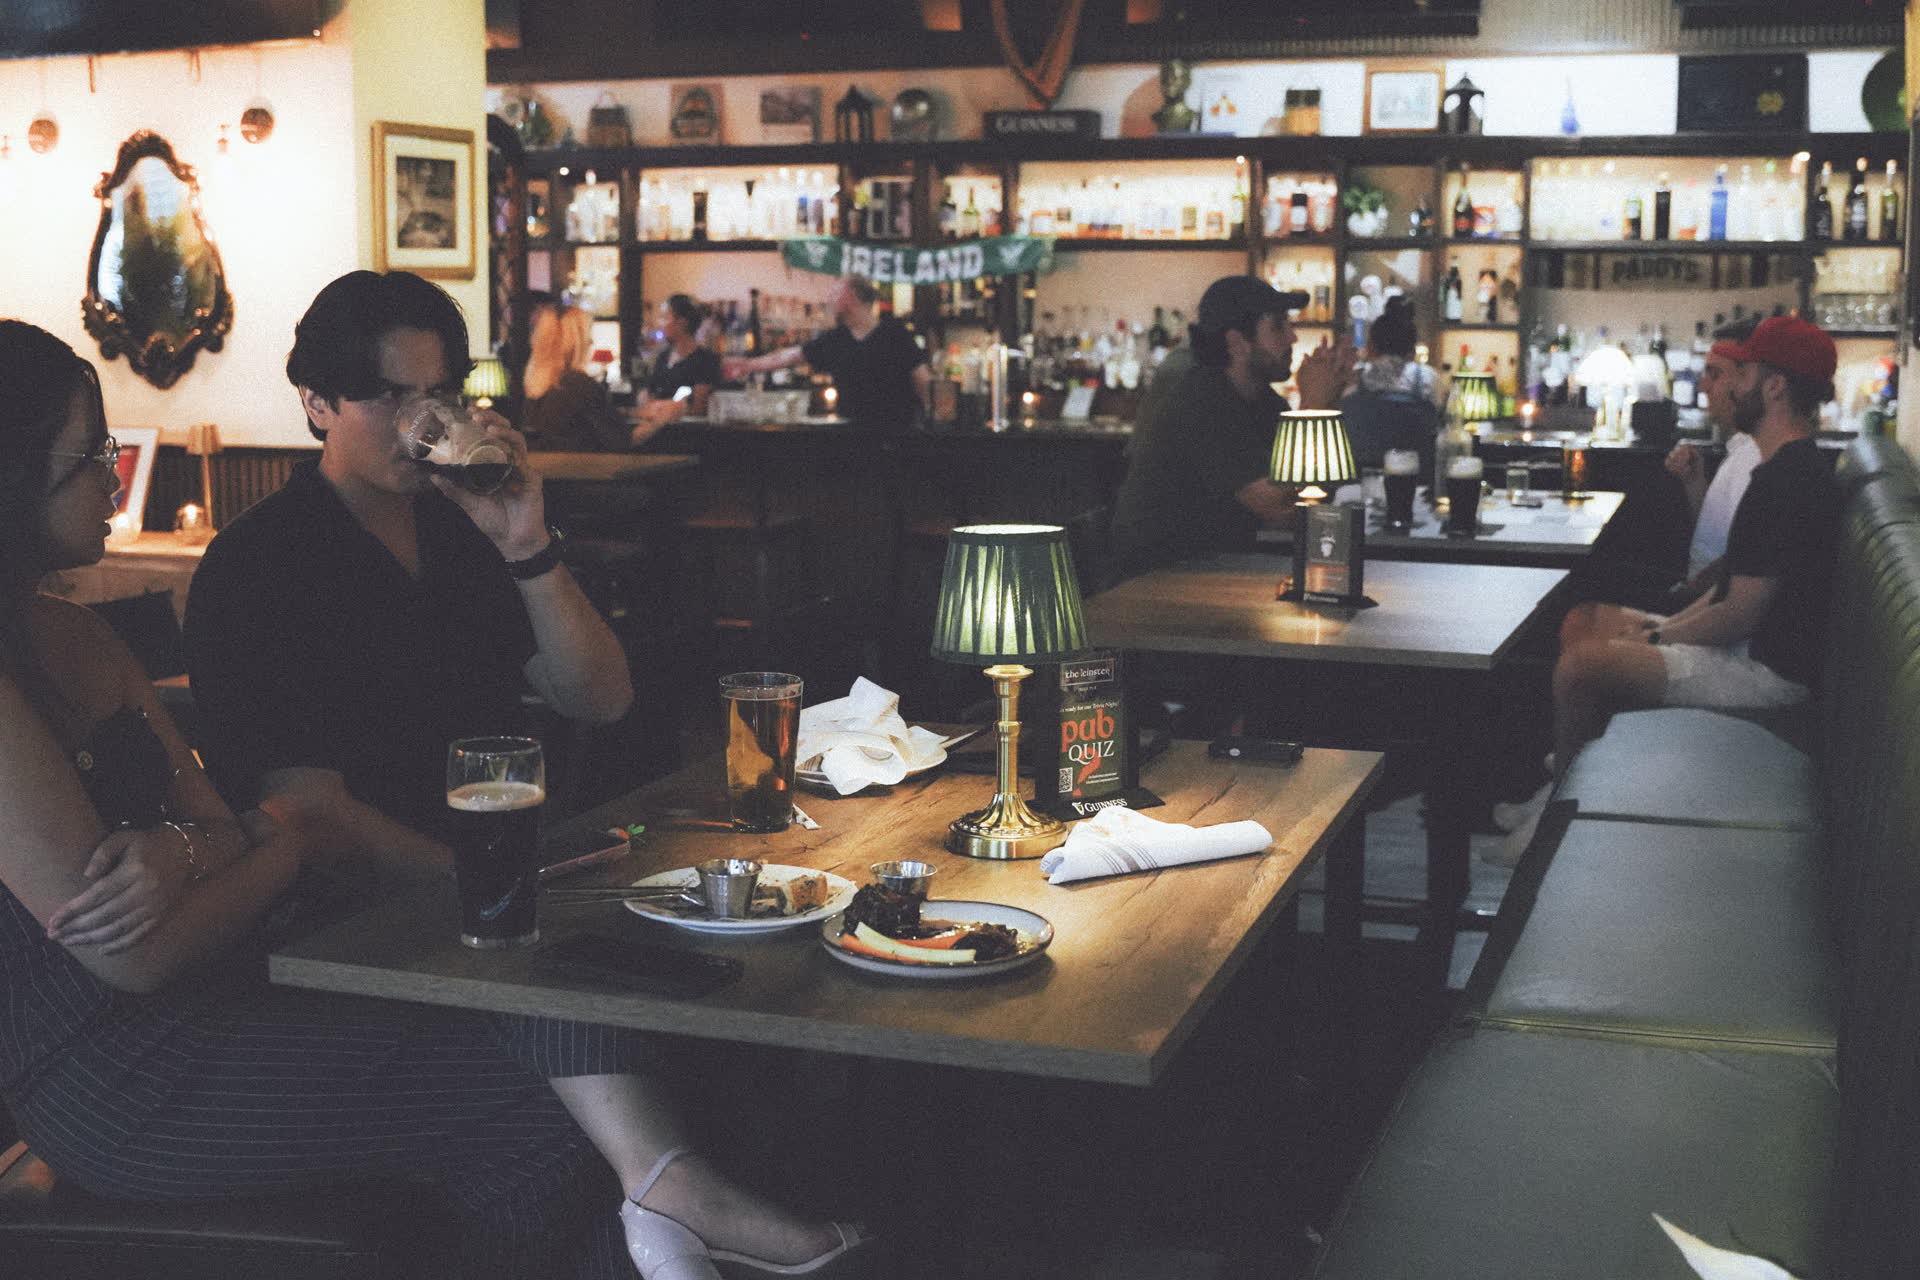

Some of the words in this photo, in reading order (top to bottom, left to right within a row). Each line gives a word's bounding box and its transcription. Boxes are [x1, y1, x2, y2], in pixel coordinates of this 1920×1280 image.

[841, 245, 984, 284] IRELAND
[1065, 669, 1079, 679] the
[1061, 708, 1115, 753] pub
[1068, 740, 1115, 765] QUIZ
[1084, 798, 1128, 813] GUINNESS
